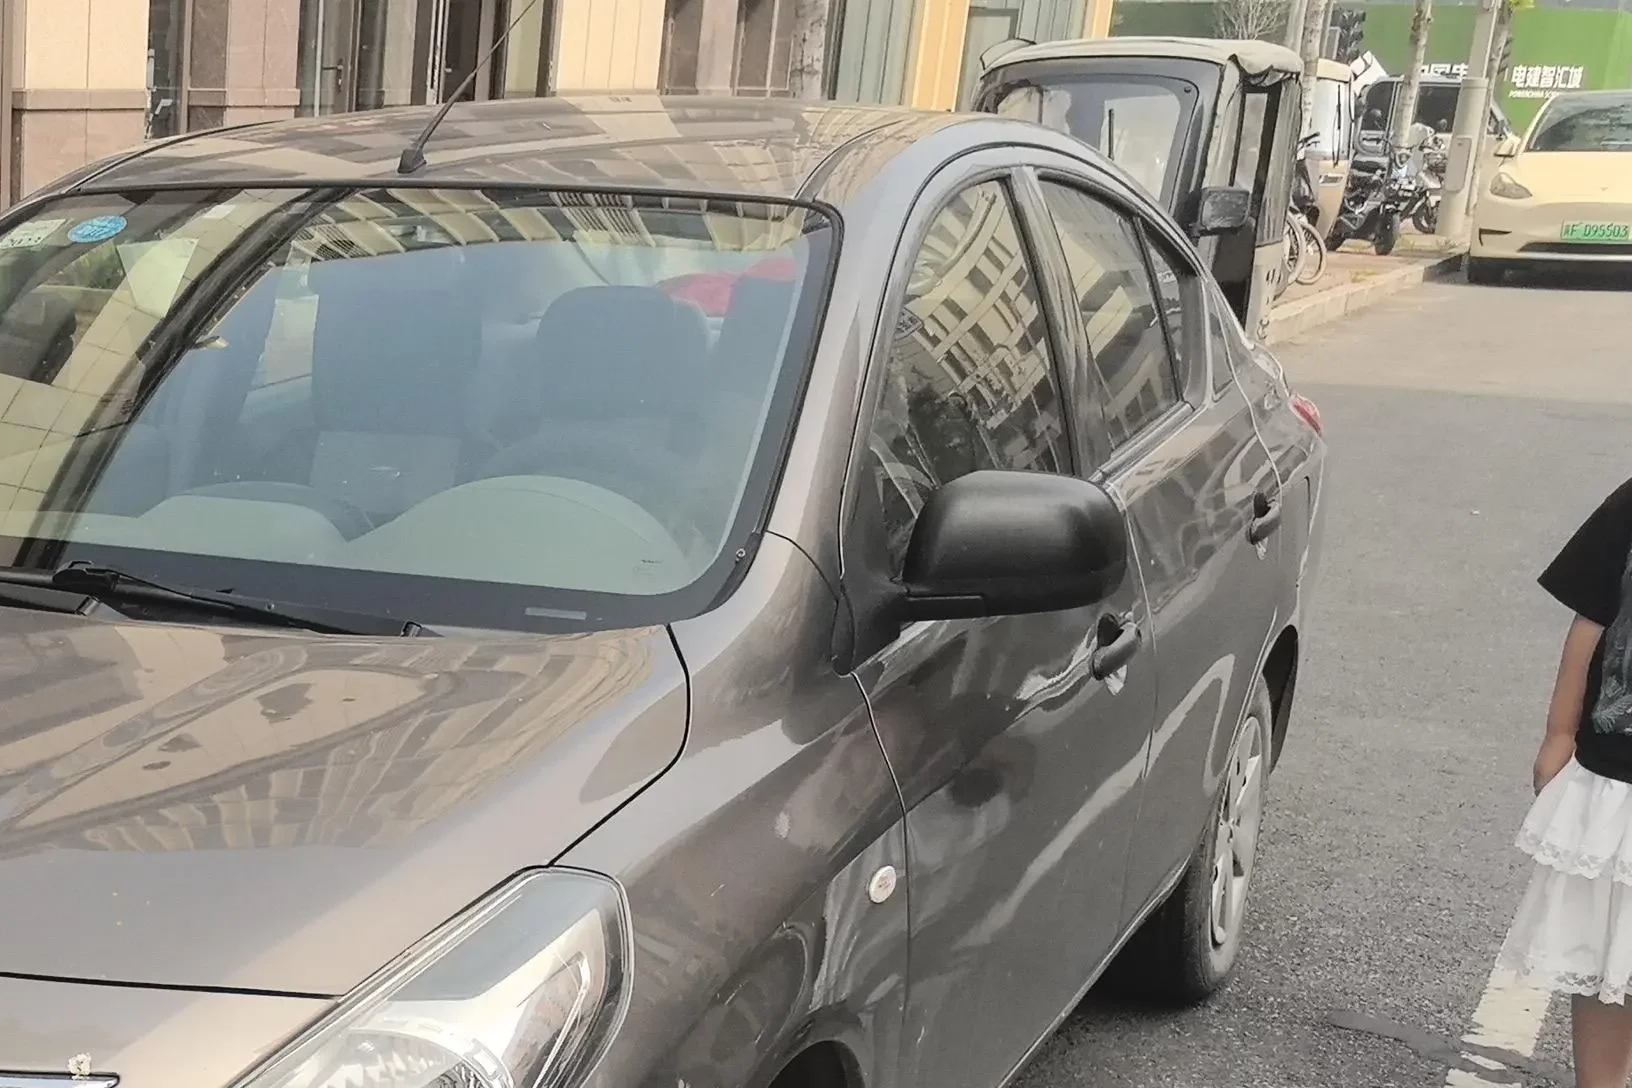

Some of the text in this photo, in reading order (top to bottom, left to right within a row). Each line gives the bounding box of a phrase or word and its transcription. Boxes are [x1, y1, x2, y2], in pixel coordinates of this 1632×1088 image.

[1511, 65, 1584, 88] 电建智汇城
